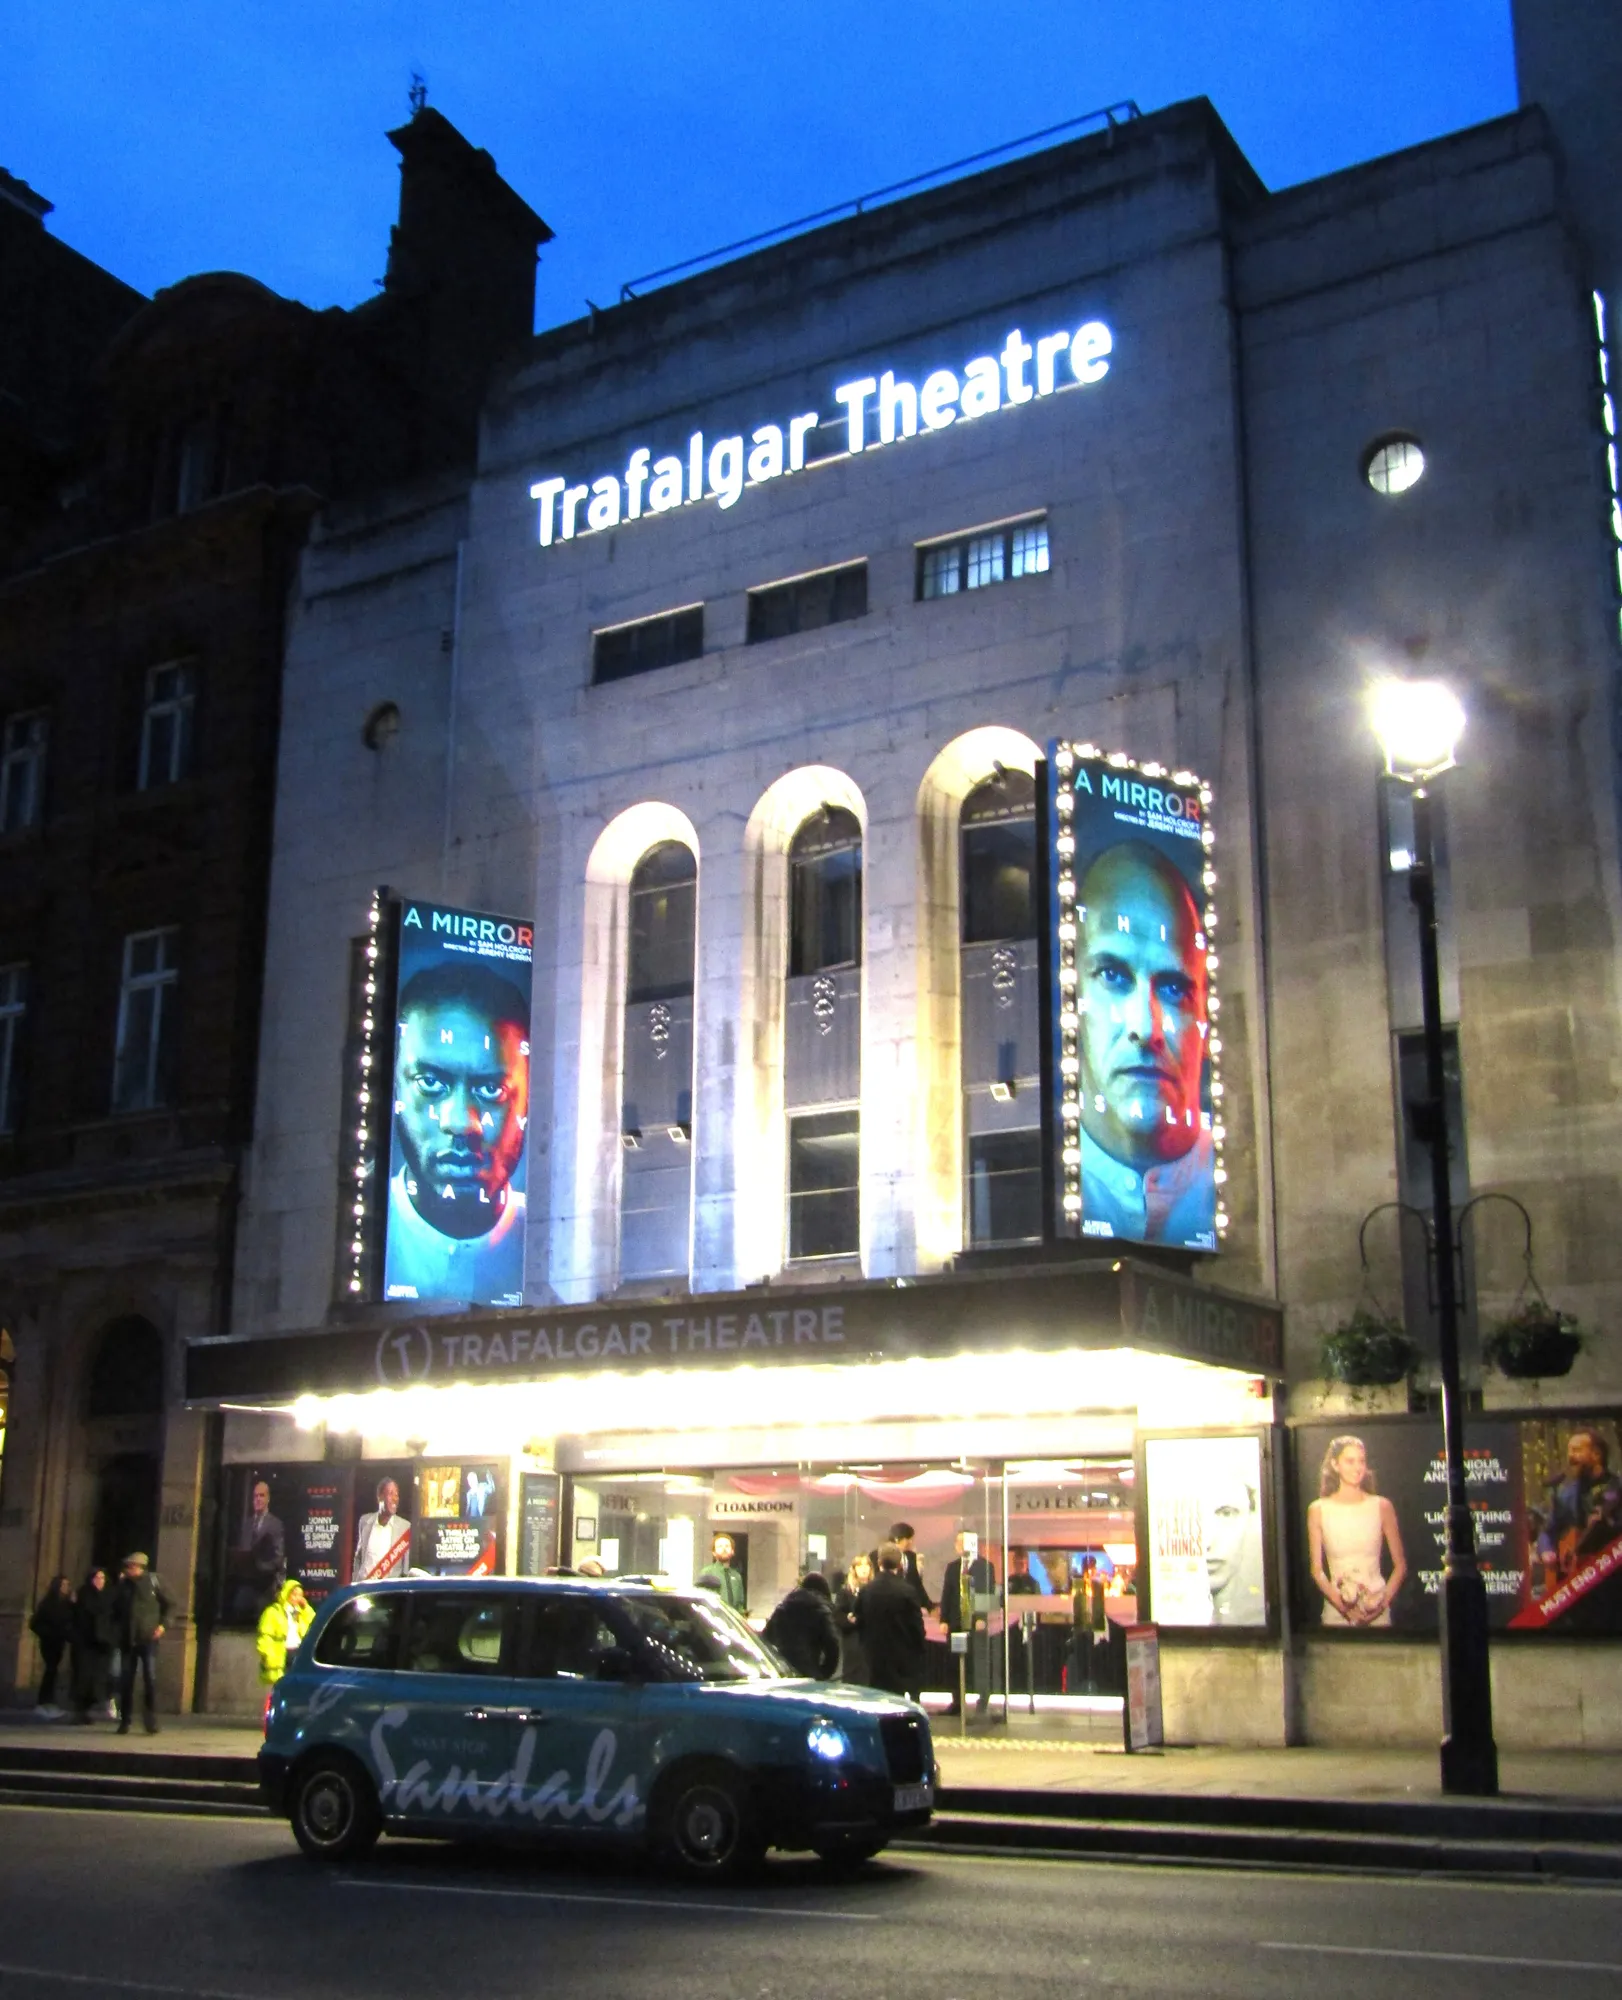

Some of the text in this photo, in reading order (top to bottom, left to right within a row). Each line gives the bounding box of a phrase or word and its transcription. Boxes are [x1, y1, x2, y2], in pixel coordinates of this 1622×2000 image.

[529, 319, 1113, 547] Trafalgar Theatre
[1074, 768, 1200, 822] A MIRROR
[1146, 819, 1174, 834] JEREMY
[1147, 810, 1163, 821] SAM
[1163, 815, 1200, 832] HOLCROFT
[403, 908, 533, 947] A MIRROR
[477, 940, 493, 949] SAM
[494, 943, 532, 955] HOLCROFT
[477, 947, 504, 958] JEREMY
[505, 952, 532, 963] HERRIN
[442, 1306, 846, 1367] TRAFALGAR THEATRE
[1430, 1458, 1500, 1470] 'INNIOUS
[715, 1500, 794, 1514] CLOAKROOM
[301, 1525, 339, 1533] LEE MILLER
[312, 1532, 336, 1541] SIMPLY
[464, 1536, 475, 1544] ON
[464, 1543, 481, 1551] AND
[380, 1559, 391, 1572] 20
[388, 1540, 409, 1563] APRIL
[307, 1569, 338, 1578] MARVEL'
[1540, 1585, 1571, 1616] MUST
[1571, 1566, 1596, 1592] END
[1595, 1554, 1612, 1572] 20
[370, 1707, 647, 1826] Sandals
